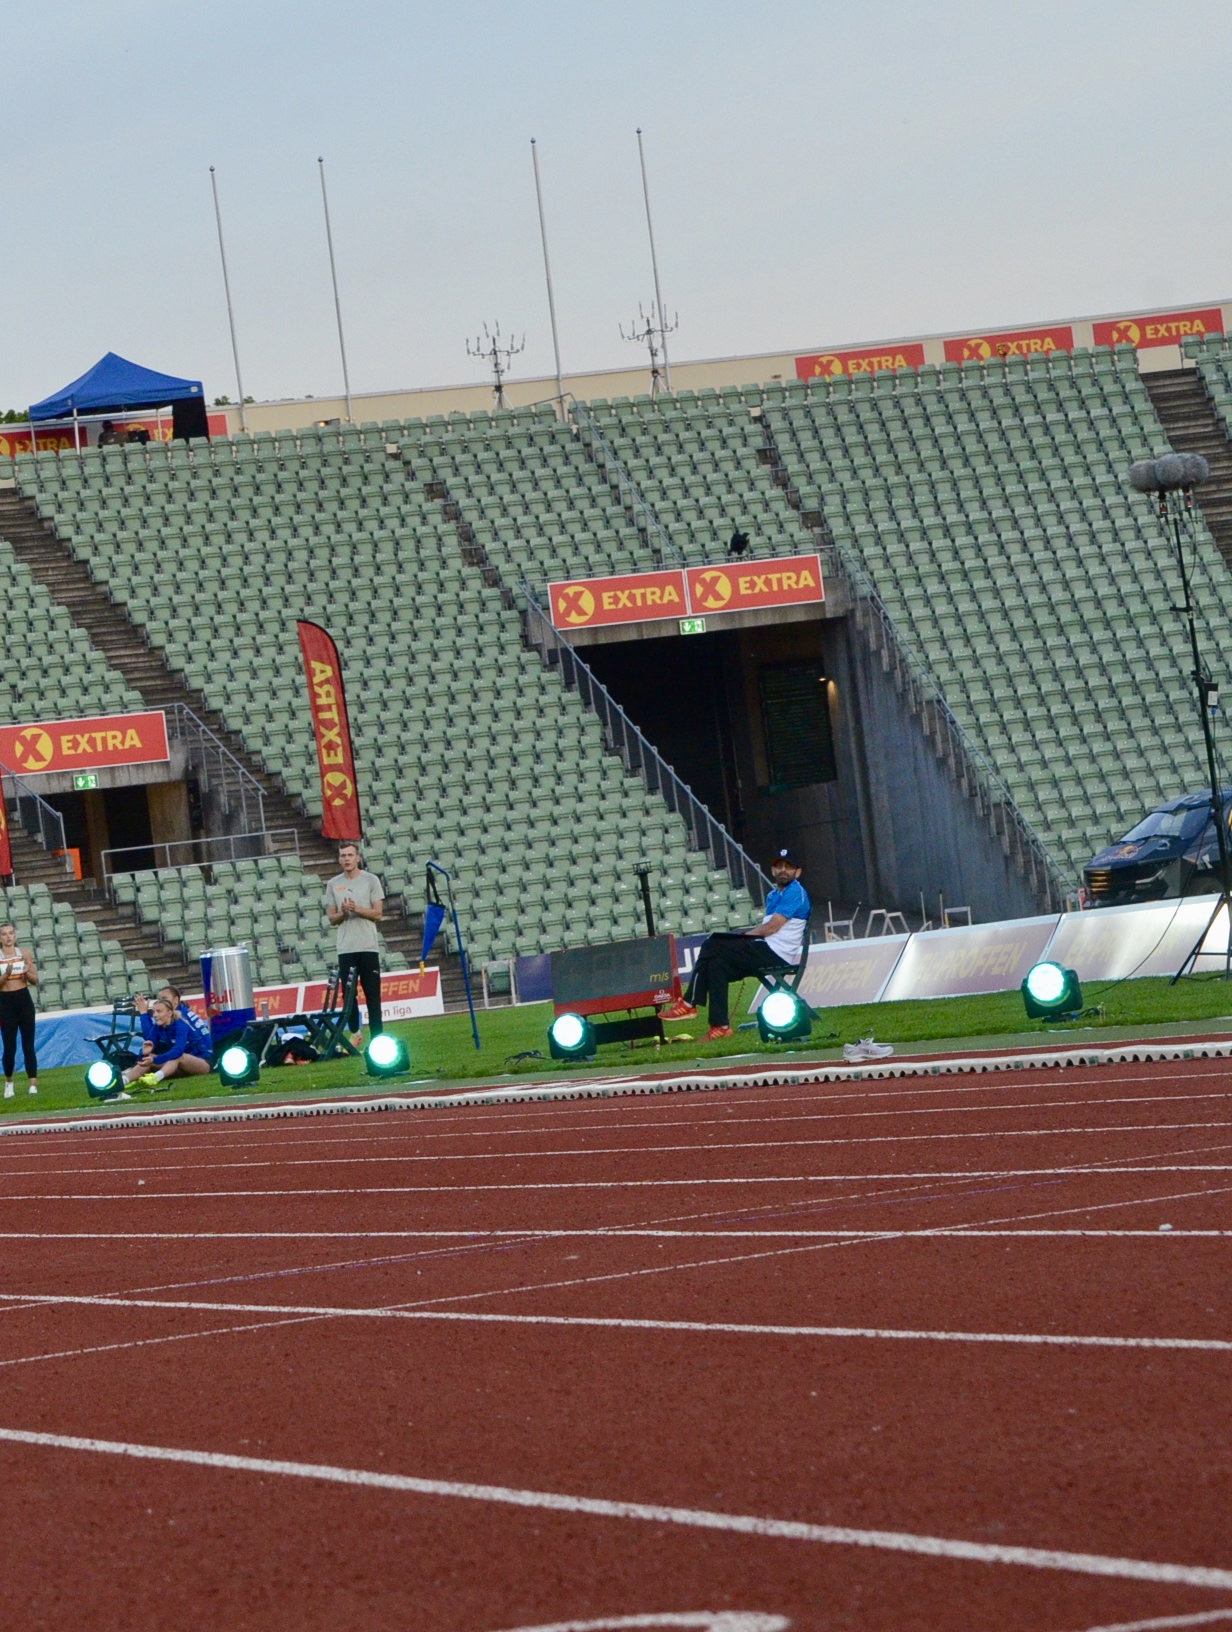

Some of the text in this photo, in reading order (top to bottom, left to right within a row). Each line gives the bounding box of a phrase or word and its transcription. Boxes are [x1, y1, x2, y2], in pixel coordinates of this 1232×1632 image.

[1146, 319, 1205, 339] EXTRA
[847, 353, 907, 373] EXTRA
[738, 570, 816, 595] EXTRA
[602, 585, 680, 610] EXTRA
[60, 728, 142, 756] EXTRA
[650, 971, 669, 982] m/s
[207, 989, 234, 1005] Bull
[393, 1005, 412, 1018] liga
